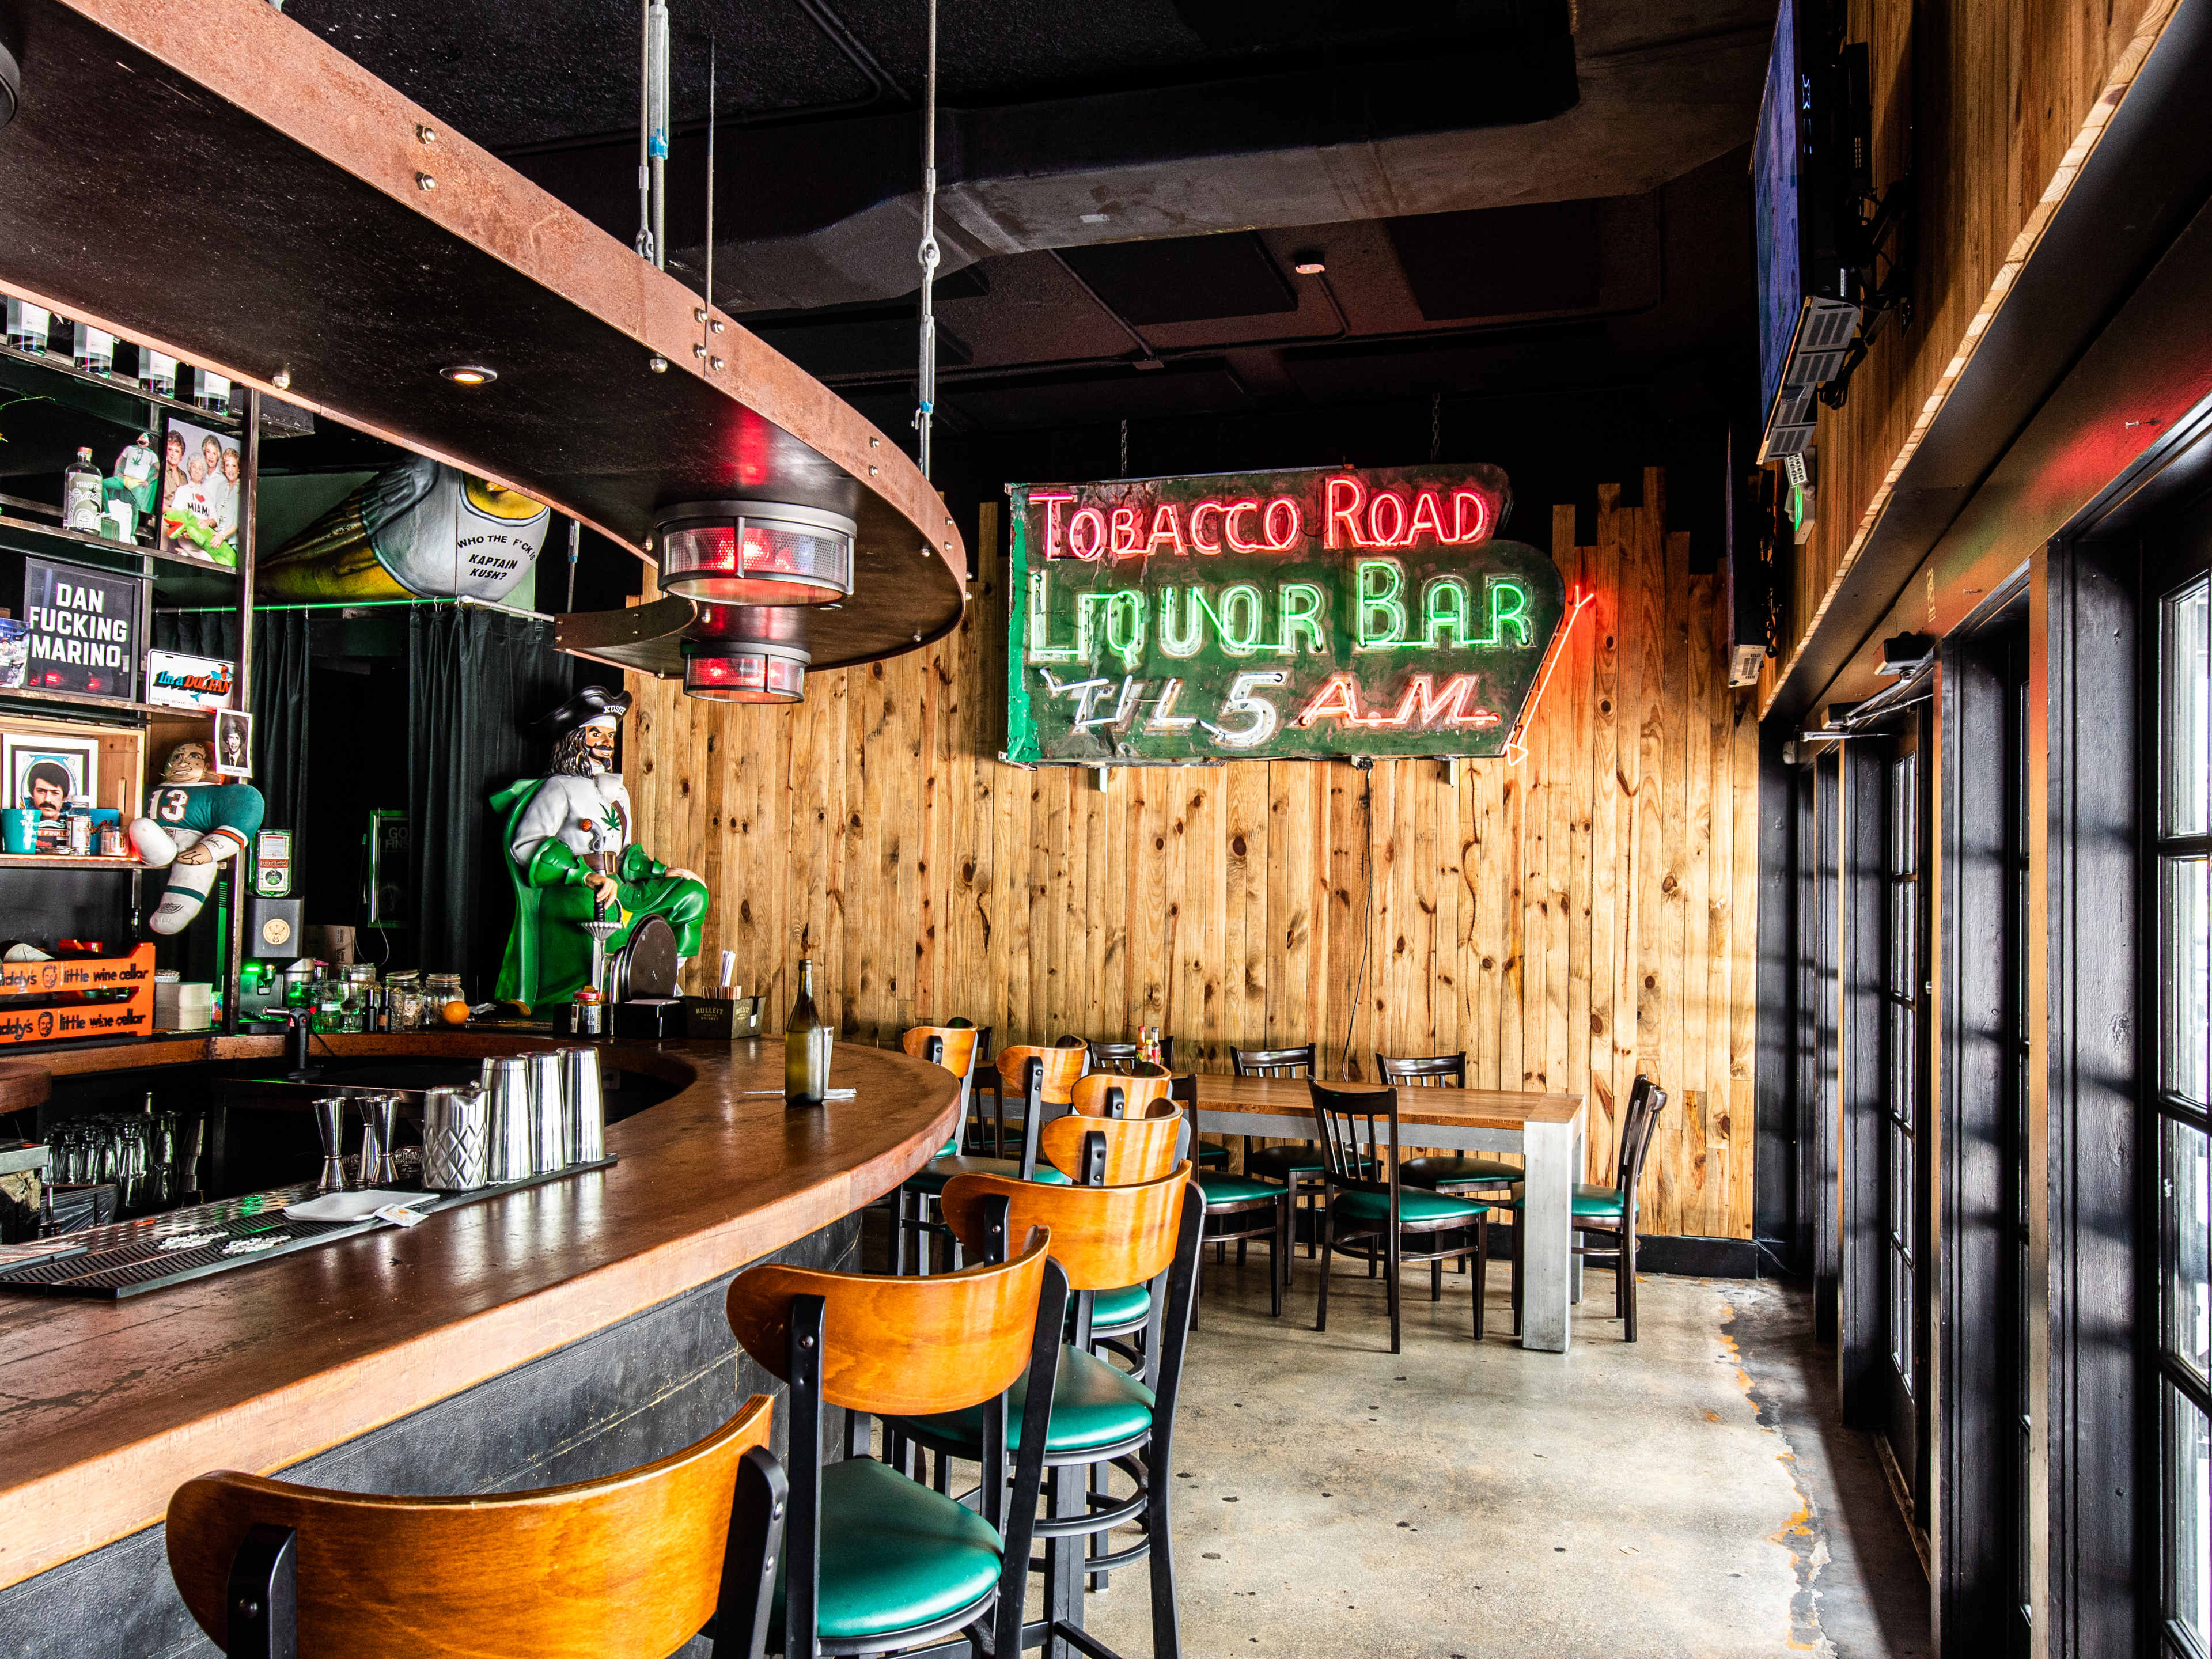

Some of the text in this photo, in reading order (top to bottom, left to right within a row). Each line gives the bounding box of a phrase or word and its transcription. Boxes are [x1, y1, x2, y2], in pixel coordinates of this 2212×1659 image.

[1028, 475, 1491, 560] TOBACCO ROAD
[457, 536, 484, 548] WHO
[487, 535, 507, 543] THE
[529, 551, 536, 561] IS
[469, 554, 518, 569] KAPTAIN
[469, 568, 507, 580] KUSH?
[56, 582, 104, 613] DAN
[28, 605, 128, 643] FUCKING
[1028, 556, 1536, 671] LIQUOR BAR
[31, 635, 122, 668] MARINO
[175, 676, 184, 686] a
[603, 705, 627, 715] KUSH
[1214, 667, 1290, 750] 5
[149, 789, 189, 823] 13
[63, 968, 89, 983] little
[93, 968, 117, 982] wine
[119, 963, 149, 980] cellar
[0, 1008, 146, 1041] ddy's little wine cellar
[696, 1006, 724, 1014] BULLEIT
